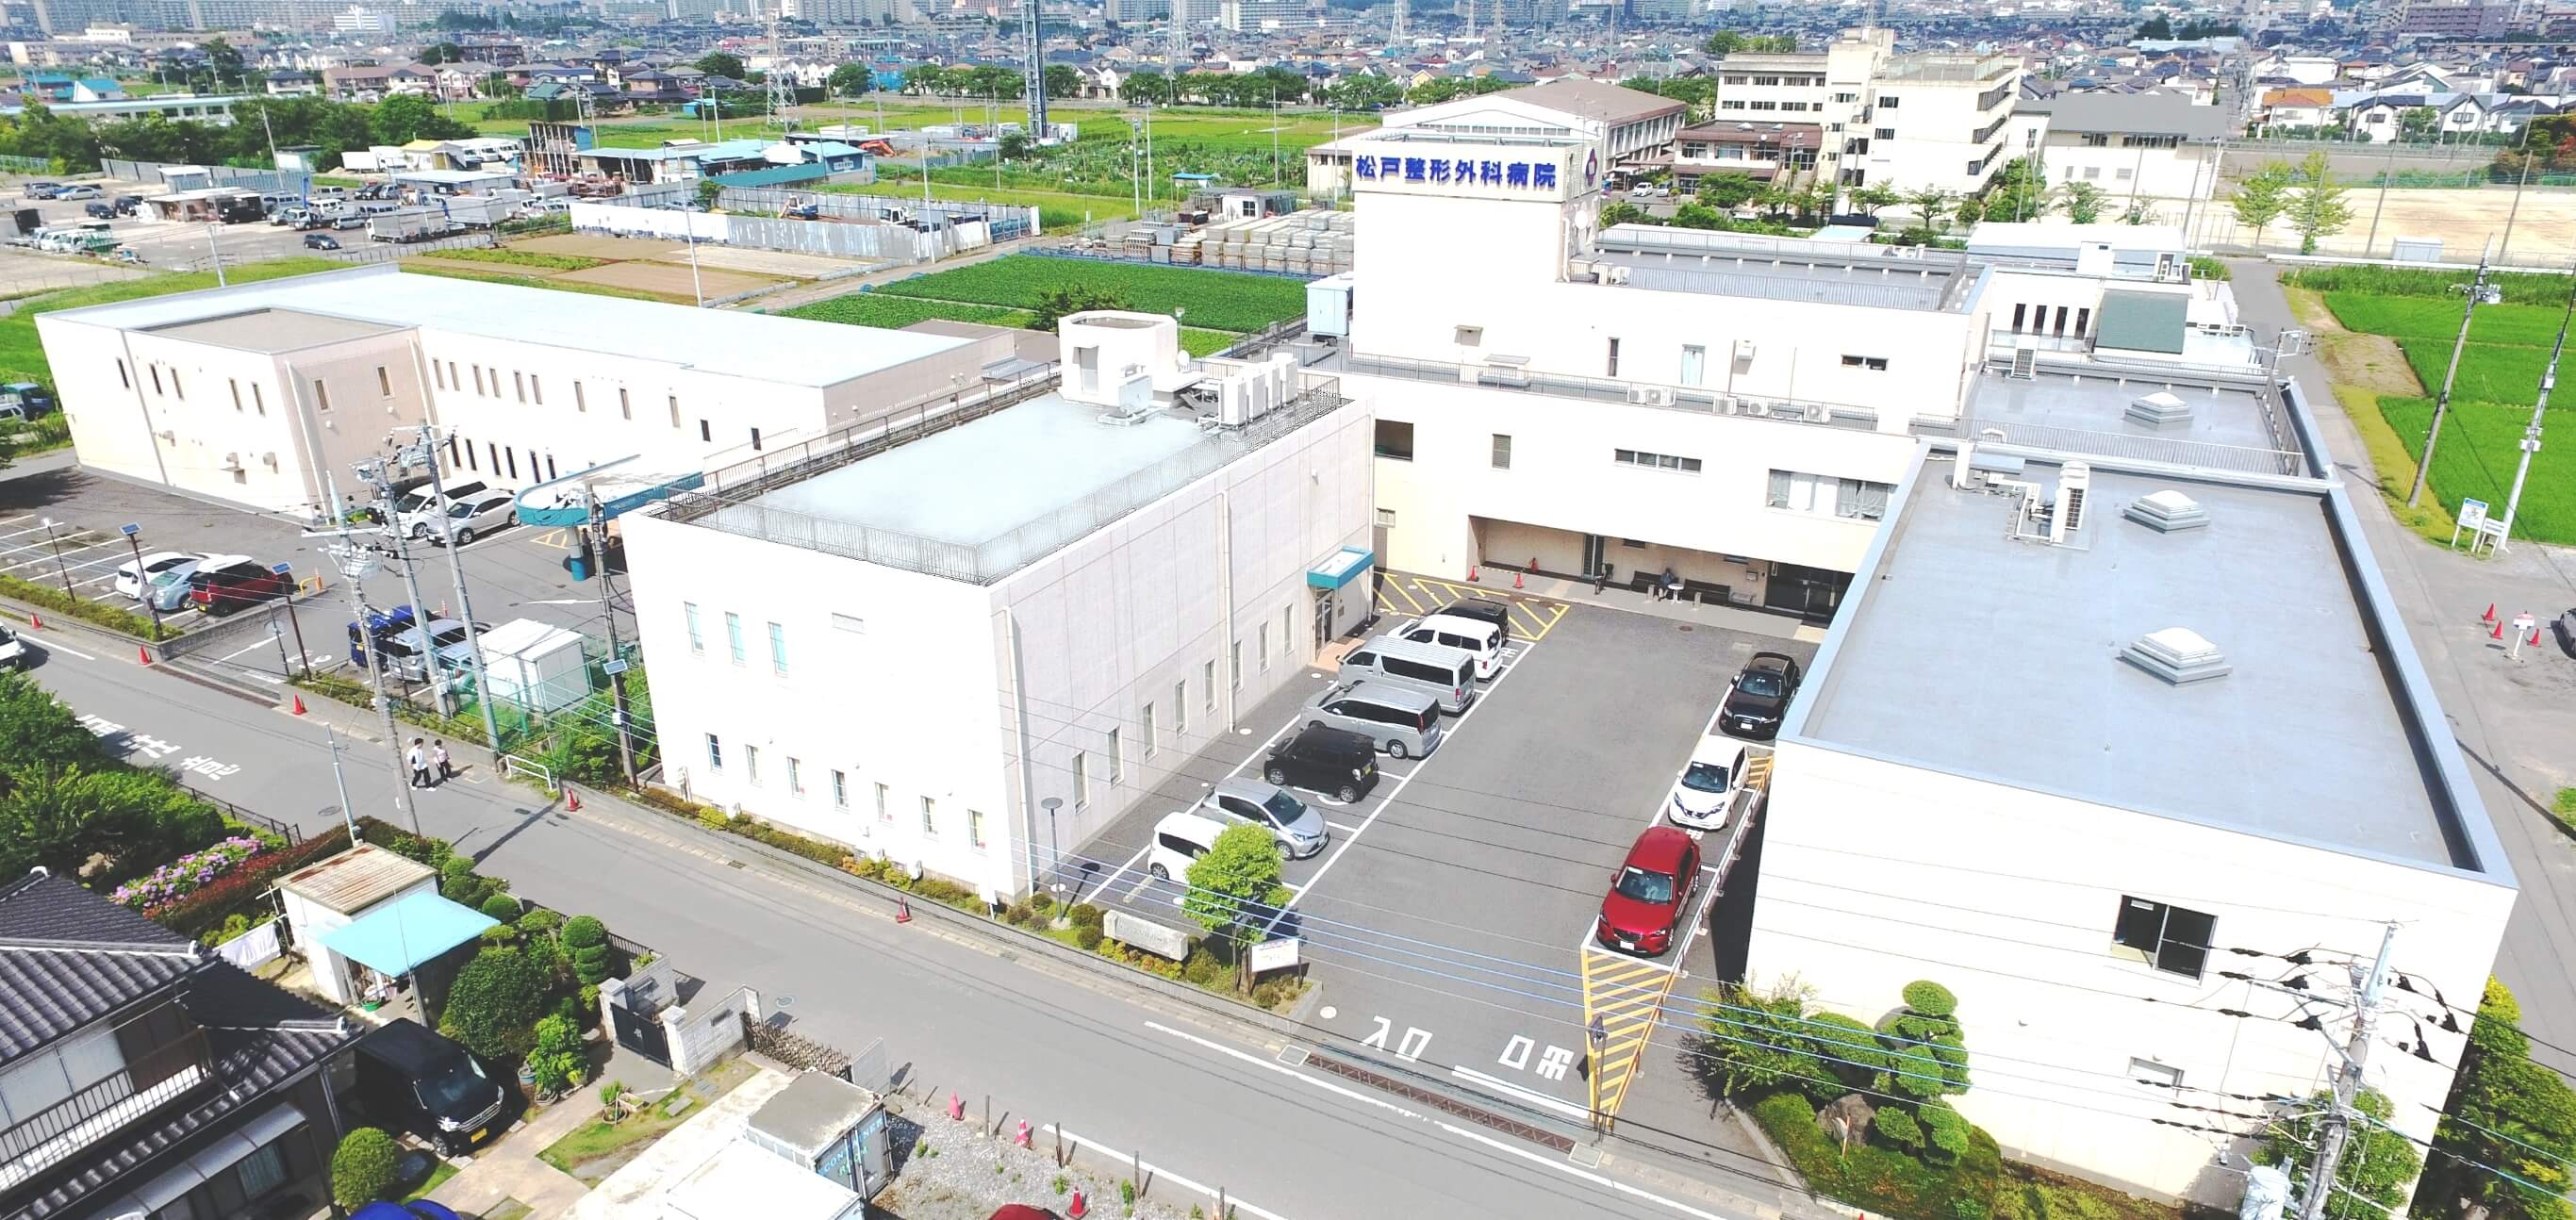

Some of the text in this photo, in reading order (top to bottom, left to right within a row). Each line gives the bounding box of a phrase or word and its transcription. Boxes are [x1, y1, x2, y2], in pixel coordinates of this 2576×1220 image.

[1356, 155, 1556, 189] 松戸整形外科病院
[1359, 1015, 1433, 1063] 入口
[822, 1116, 883, 1172] CONAINER
